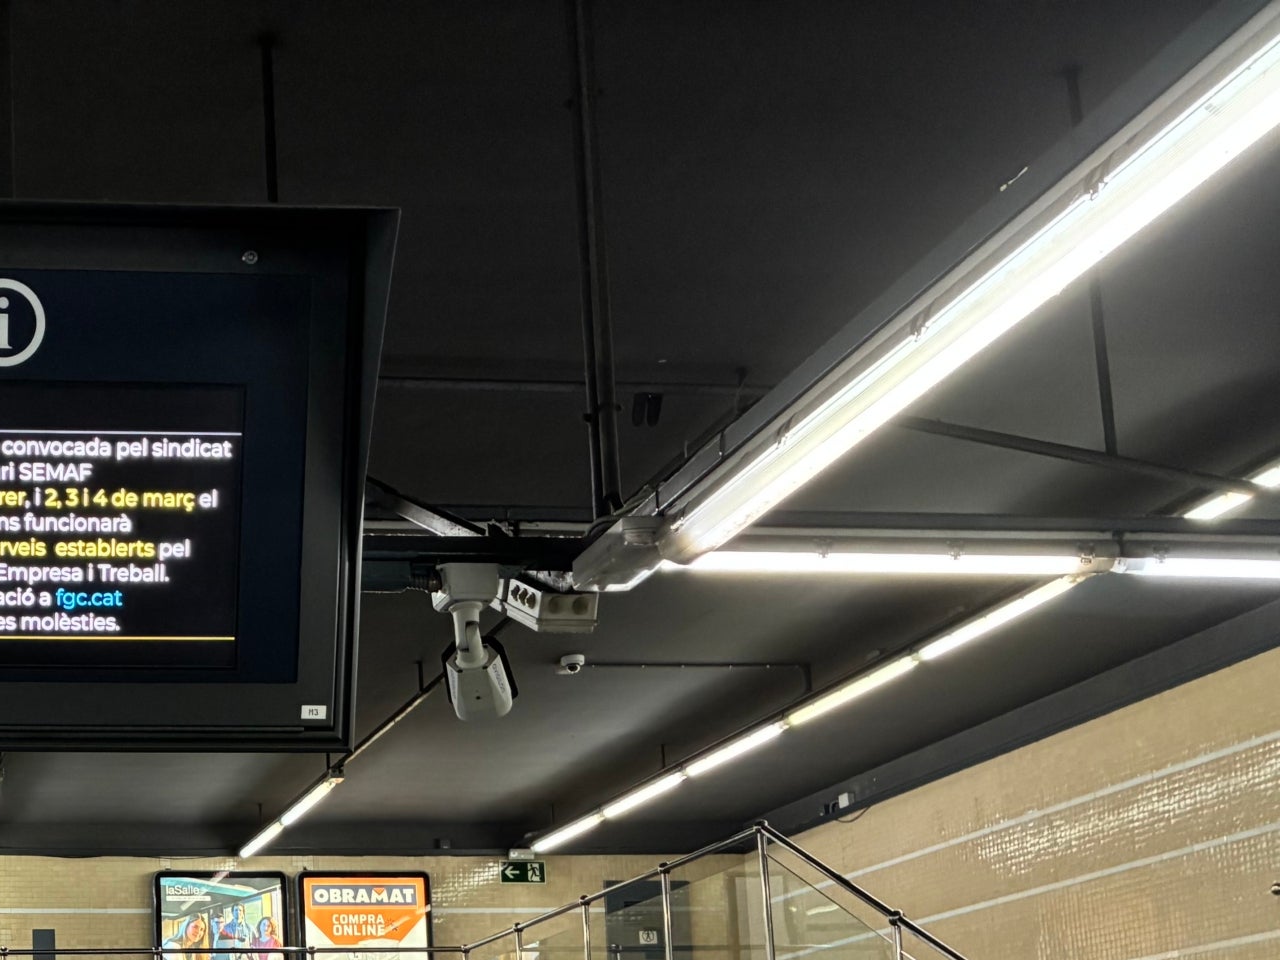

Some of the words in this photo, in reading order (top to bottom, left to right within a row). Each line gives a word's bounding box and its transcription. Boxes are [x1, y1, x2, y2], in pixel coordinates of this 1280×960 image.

[2, 437, 111, 457] convocada
[117, 438, 148, 461] pel
[152, 438, 232, 458] sindicat
[19, 463, 93, 482] SEMAF
[34, 487, 41, 506] i
[45, 488, 62, 508] 2,
[66, 488, 79, 506] 3
[83, 487, 88, 506] i
[93, 488, 108, 507] 4
[111, 488, 138, 507] de
[143, 492, 196, 512] març
[198, 489, 218, 508] el
[23, 512, 133, 532] funcionarà
[54, 538, 155, 557] establerts
[158, 538, 191, 560] pel
[88, 563, 93, 581] i
[98, 563, 169, 582] Treball.
[39, 591, 52, 606] a
[56, 588, 122, 609] fgc.cat
[21, 612, 121, 631] molèsties.
[166, 885, 200, 895] laSalle
[314, 888, 414, 903] OBRAMAT
[332, 914, 385, 925] COMPRA
[332, 924, 386, 936] ONLINE
